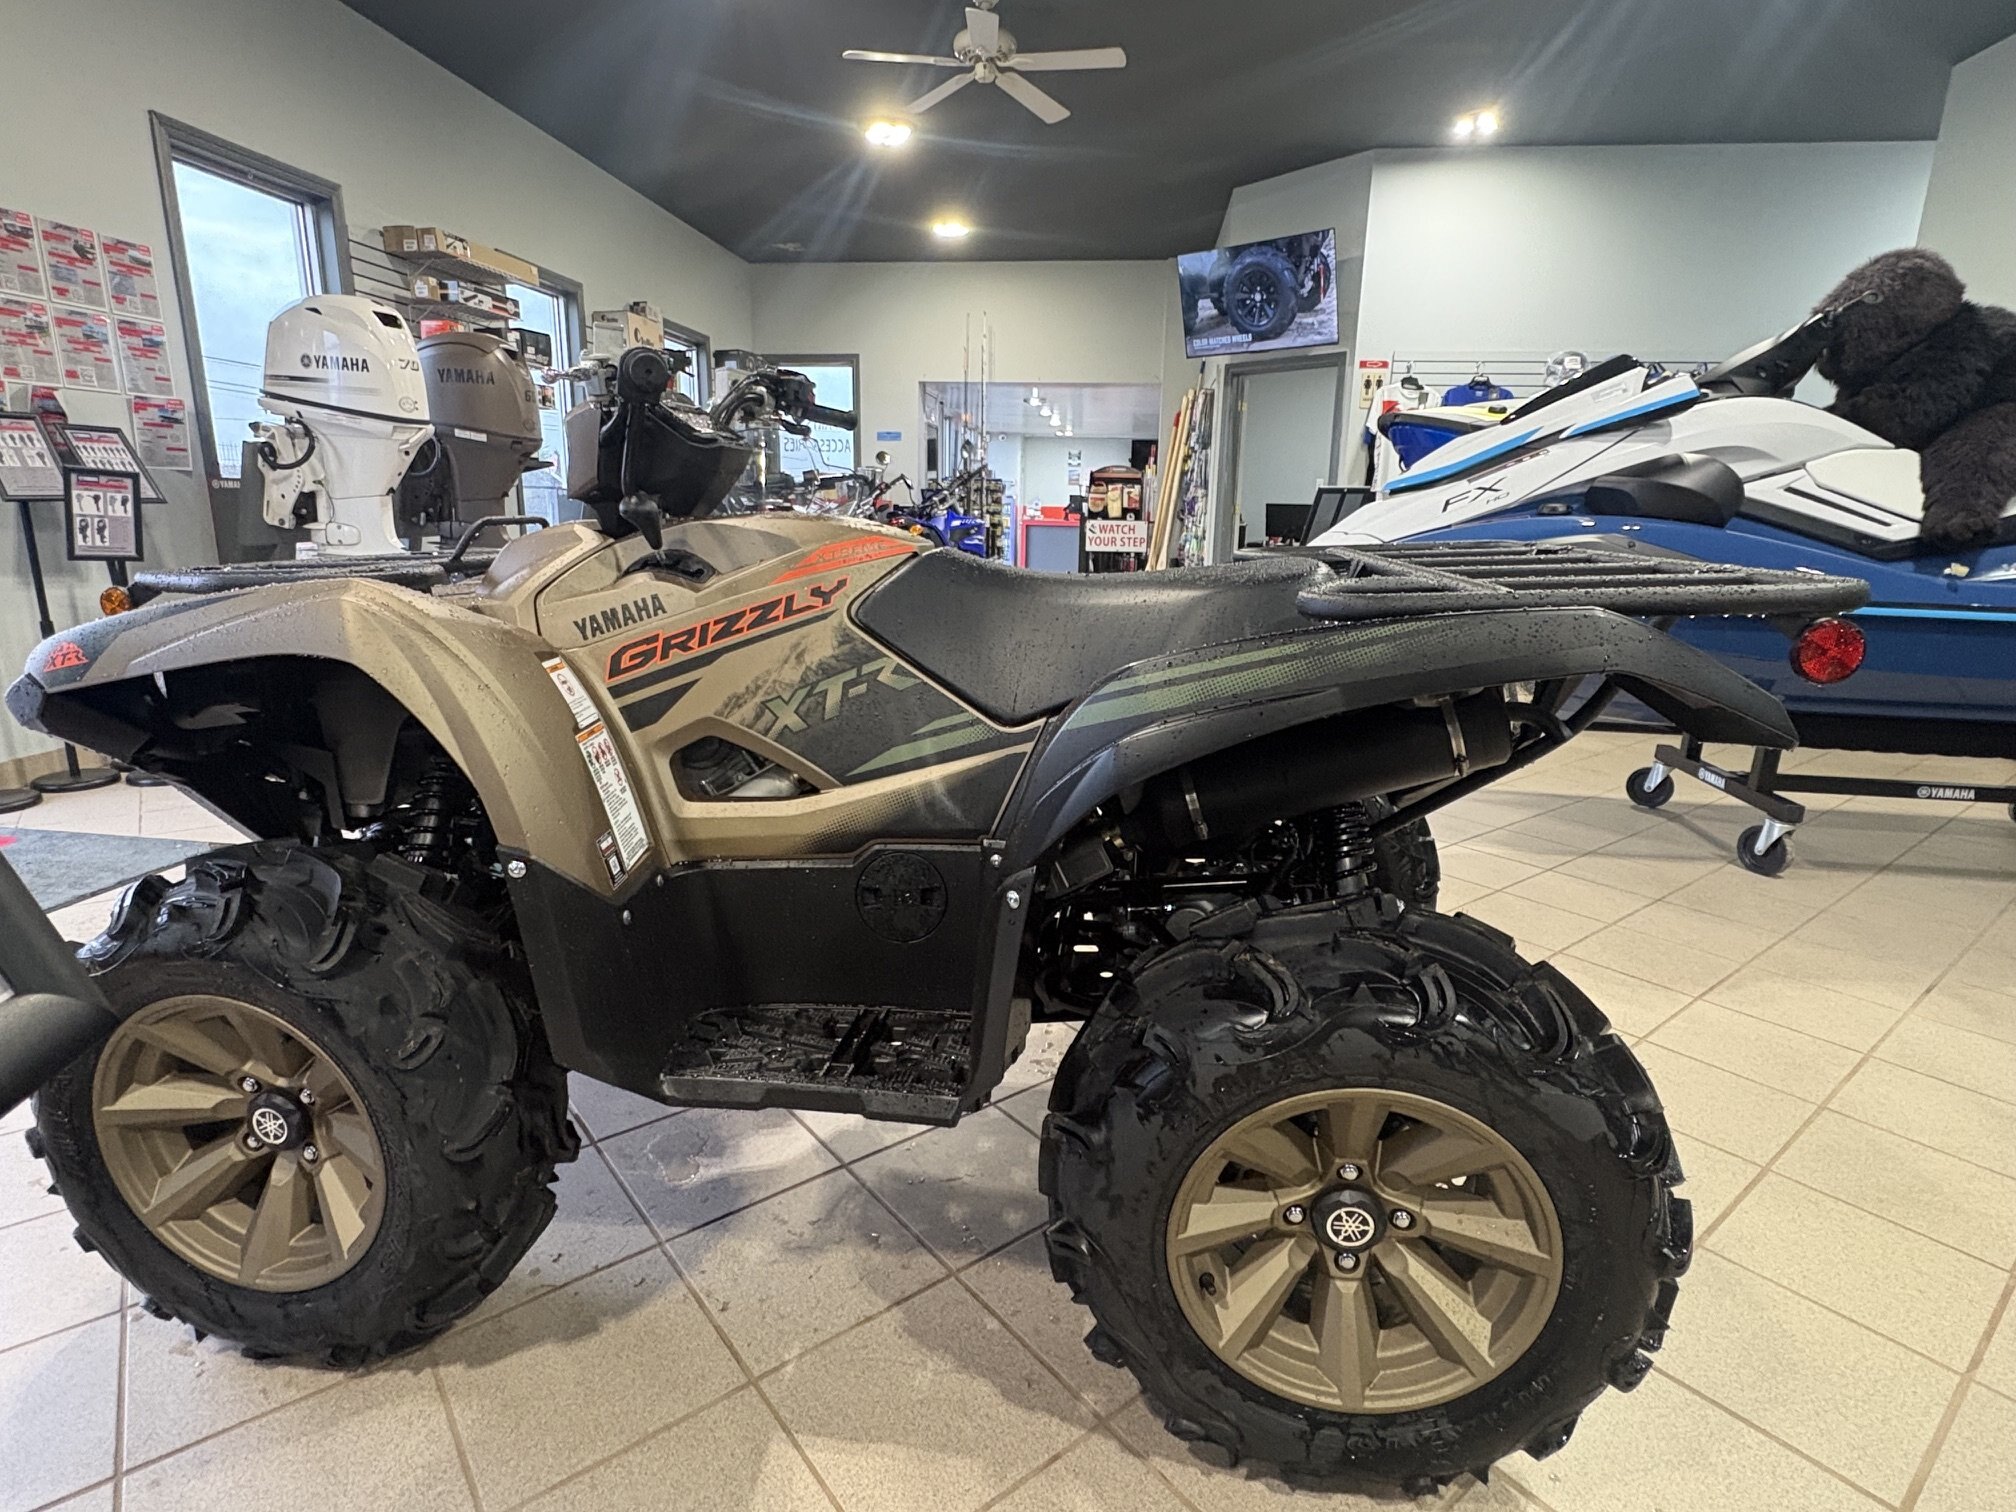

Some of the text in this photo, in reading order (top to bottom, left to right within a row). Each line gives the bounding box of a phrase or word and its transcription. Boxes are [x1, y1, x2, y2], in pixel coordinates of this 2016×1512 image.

[1231, 333, 1253, 343] WHEELS
[313, 354, 370, 373] YAMAHA
[397, 357, 420, 372] 70
[436, 367, 496, 386] YAMAHA
[1440, 476, 1508, 513] FX
[1486, 490, 1511, 505] HO
[1098, 524, 1136, 535] WATCH
[1087, 536, 1146, 548] YOUR STEP
[572, 592, 668, 641] YAMAHA
[605, 575, 850, 683] GRIZZLY
[1704, 768, 1726, 790] YAMAHA
[1930, 786, 1976, 800] YAMAHA
